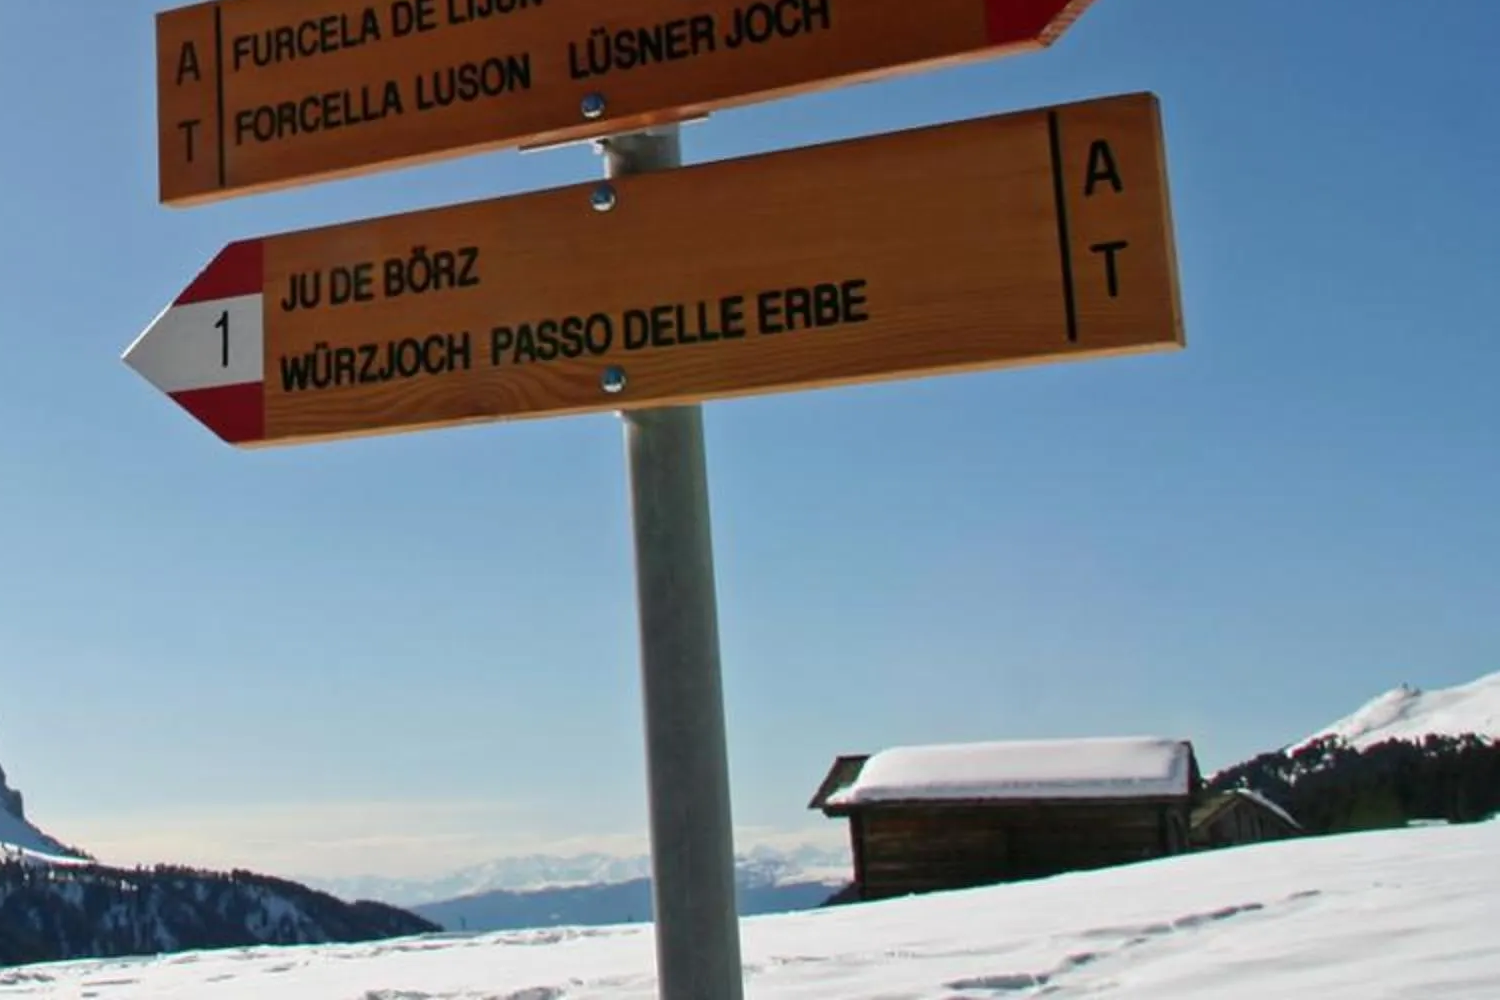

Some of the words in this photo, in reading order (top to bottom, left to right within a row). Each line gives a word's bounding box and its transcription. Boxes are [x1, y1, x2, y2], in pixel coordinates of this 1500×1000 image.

[175, 41, 201, 85] A
[232, 8, 381, 72] FURCELA
[568, 14, 717, 80] LÜSNER
[234, 79, 404, 146] FORCELLA
[415, 53, 532, 111] LUSON
[178, 119, 200, 163] T
[1084, 139, 1123, 197] A
[281, 272, 321, 312] JU
[329, 263, 374, 301] DE
[384, 245, 480, 297] BÖRZ
[1090, 240, 1128, 298] T
[213, 310, 229, 368] 1
[490, 312, 613, 365] PASSO
[623, 297, 746, 351] DELLE
[757, 279, 870, 334] ERBE
[280, 332, 472, 394] WÜRZJOCH
